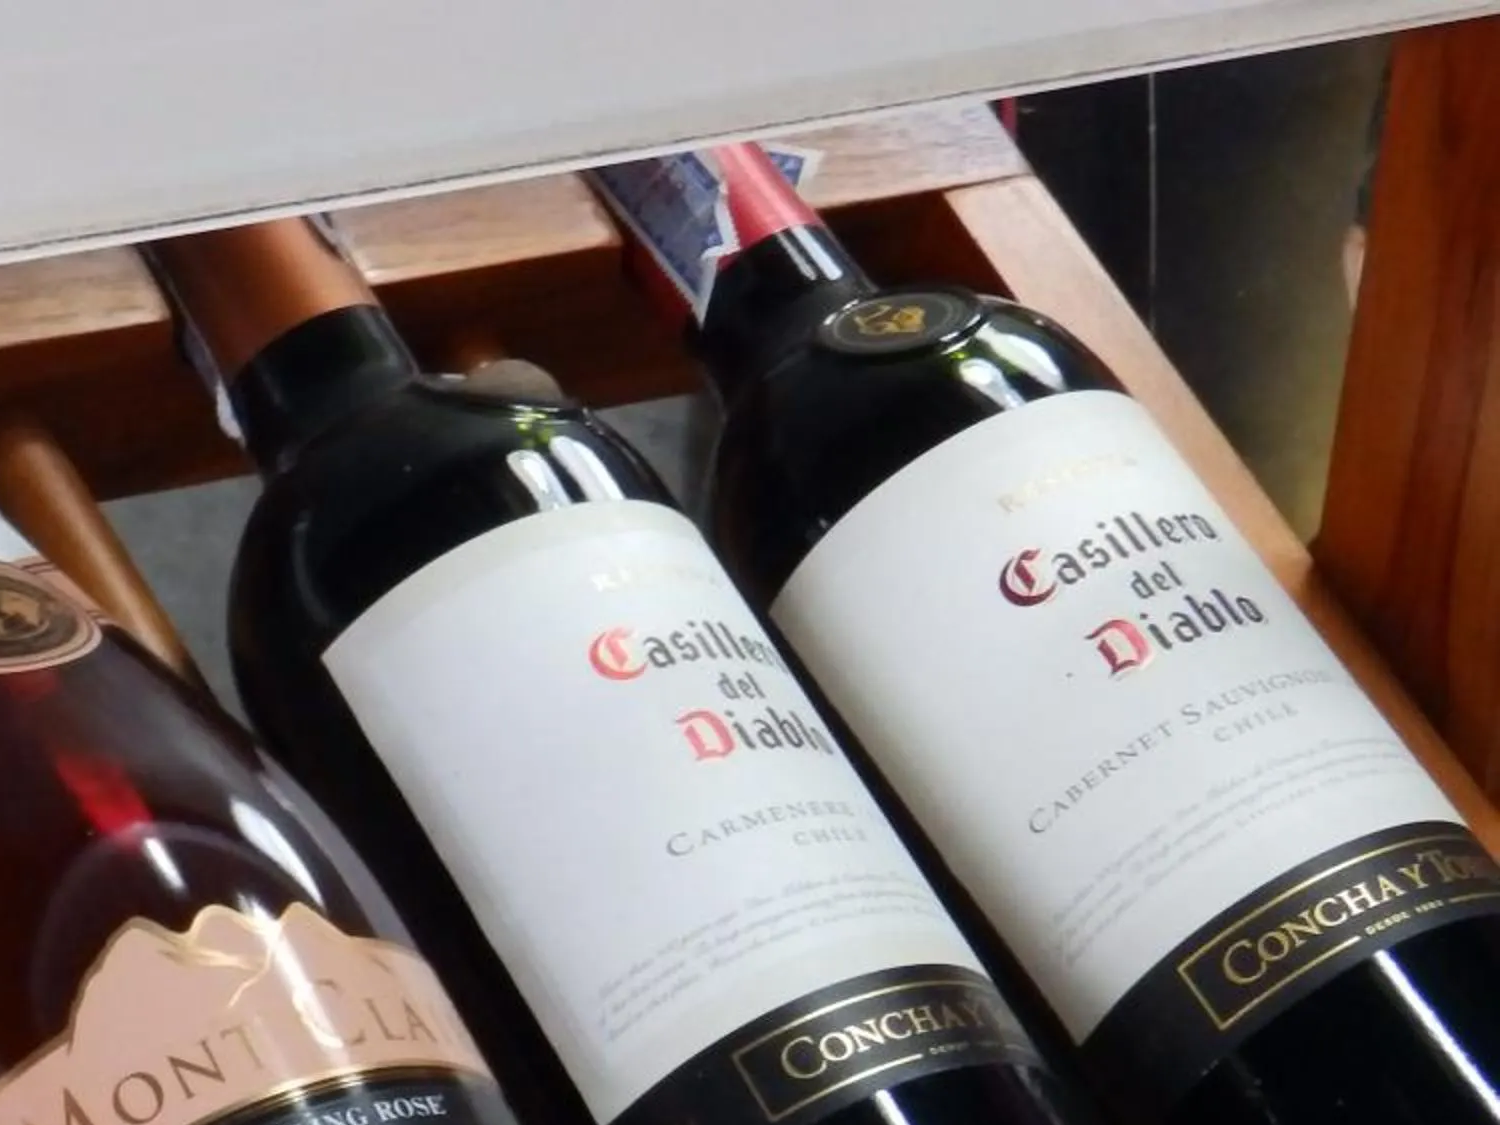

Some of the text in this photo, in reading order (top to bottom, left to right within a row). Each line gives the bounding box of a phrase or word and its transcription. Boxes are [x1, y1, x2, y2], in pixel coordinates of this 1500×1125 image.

[998, 510, 1222, 607] Casillero
[1130, 561, 1184, 601] del
[1083, 586, 1268, 679] Diablo
[717, 671, 766, 702] del
[1212, 701, 1300, 745] CHILE
[1027, 718, 1174, 836] CABERNET
